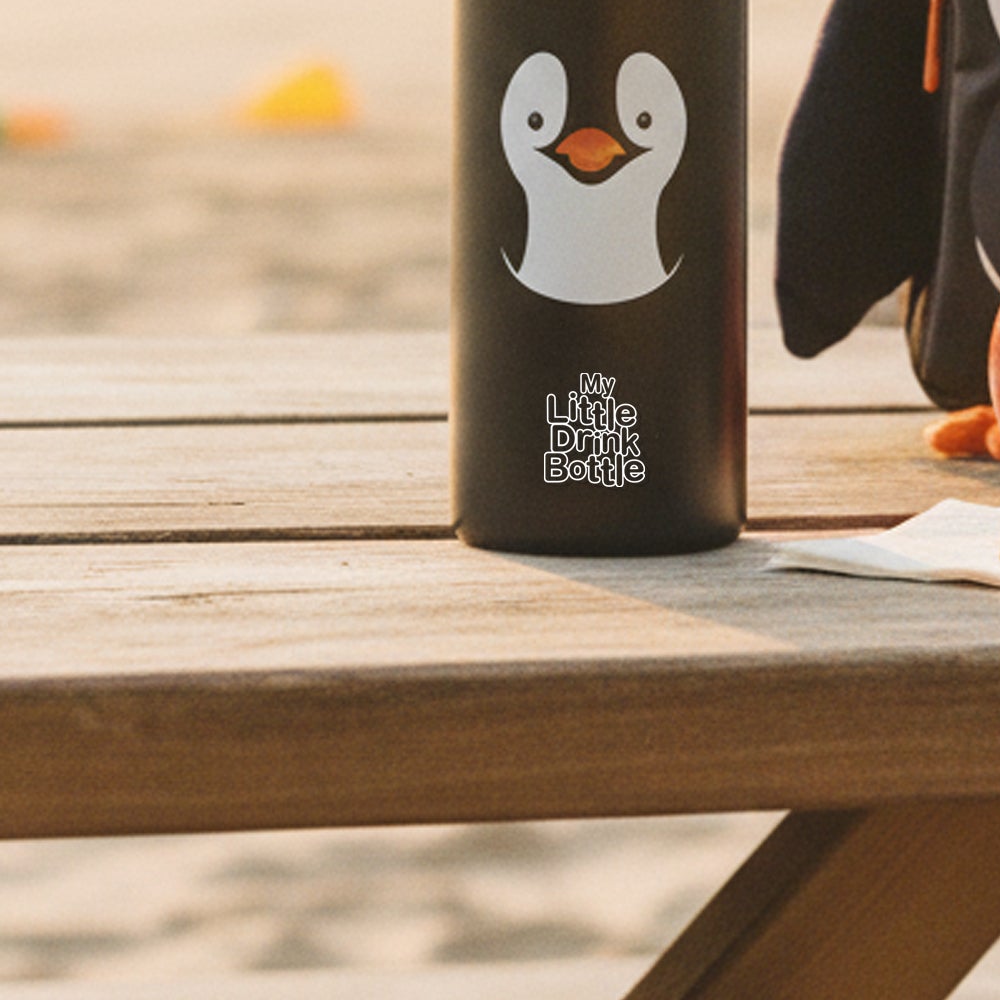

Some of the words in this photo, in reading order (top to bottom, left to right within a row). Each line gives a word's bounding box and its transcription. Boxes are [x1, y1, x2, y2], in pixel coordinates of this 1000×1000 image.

[580, 372, 616, 399] My
[546, 390, 638, 432] Little
[550, 423, 641, 457] Drink
[543, 451, 645, 488] Bottle
